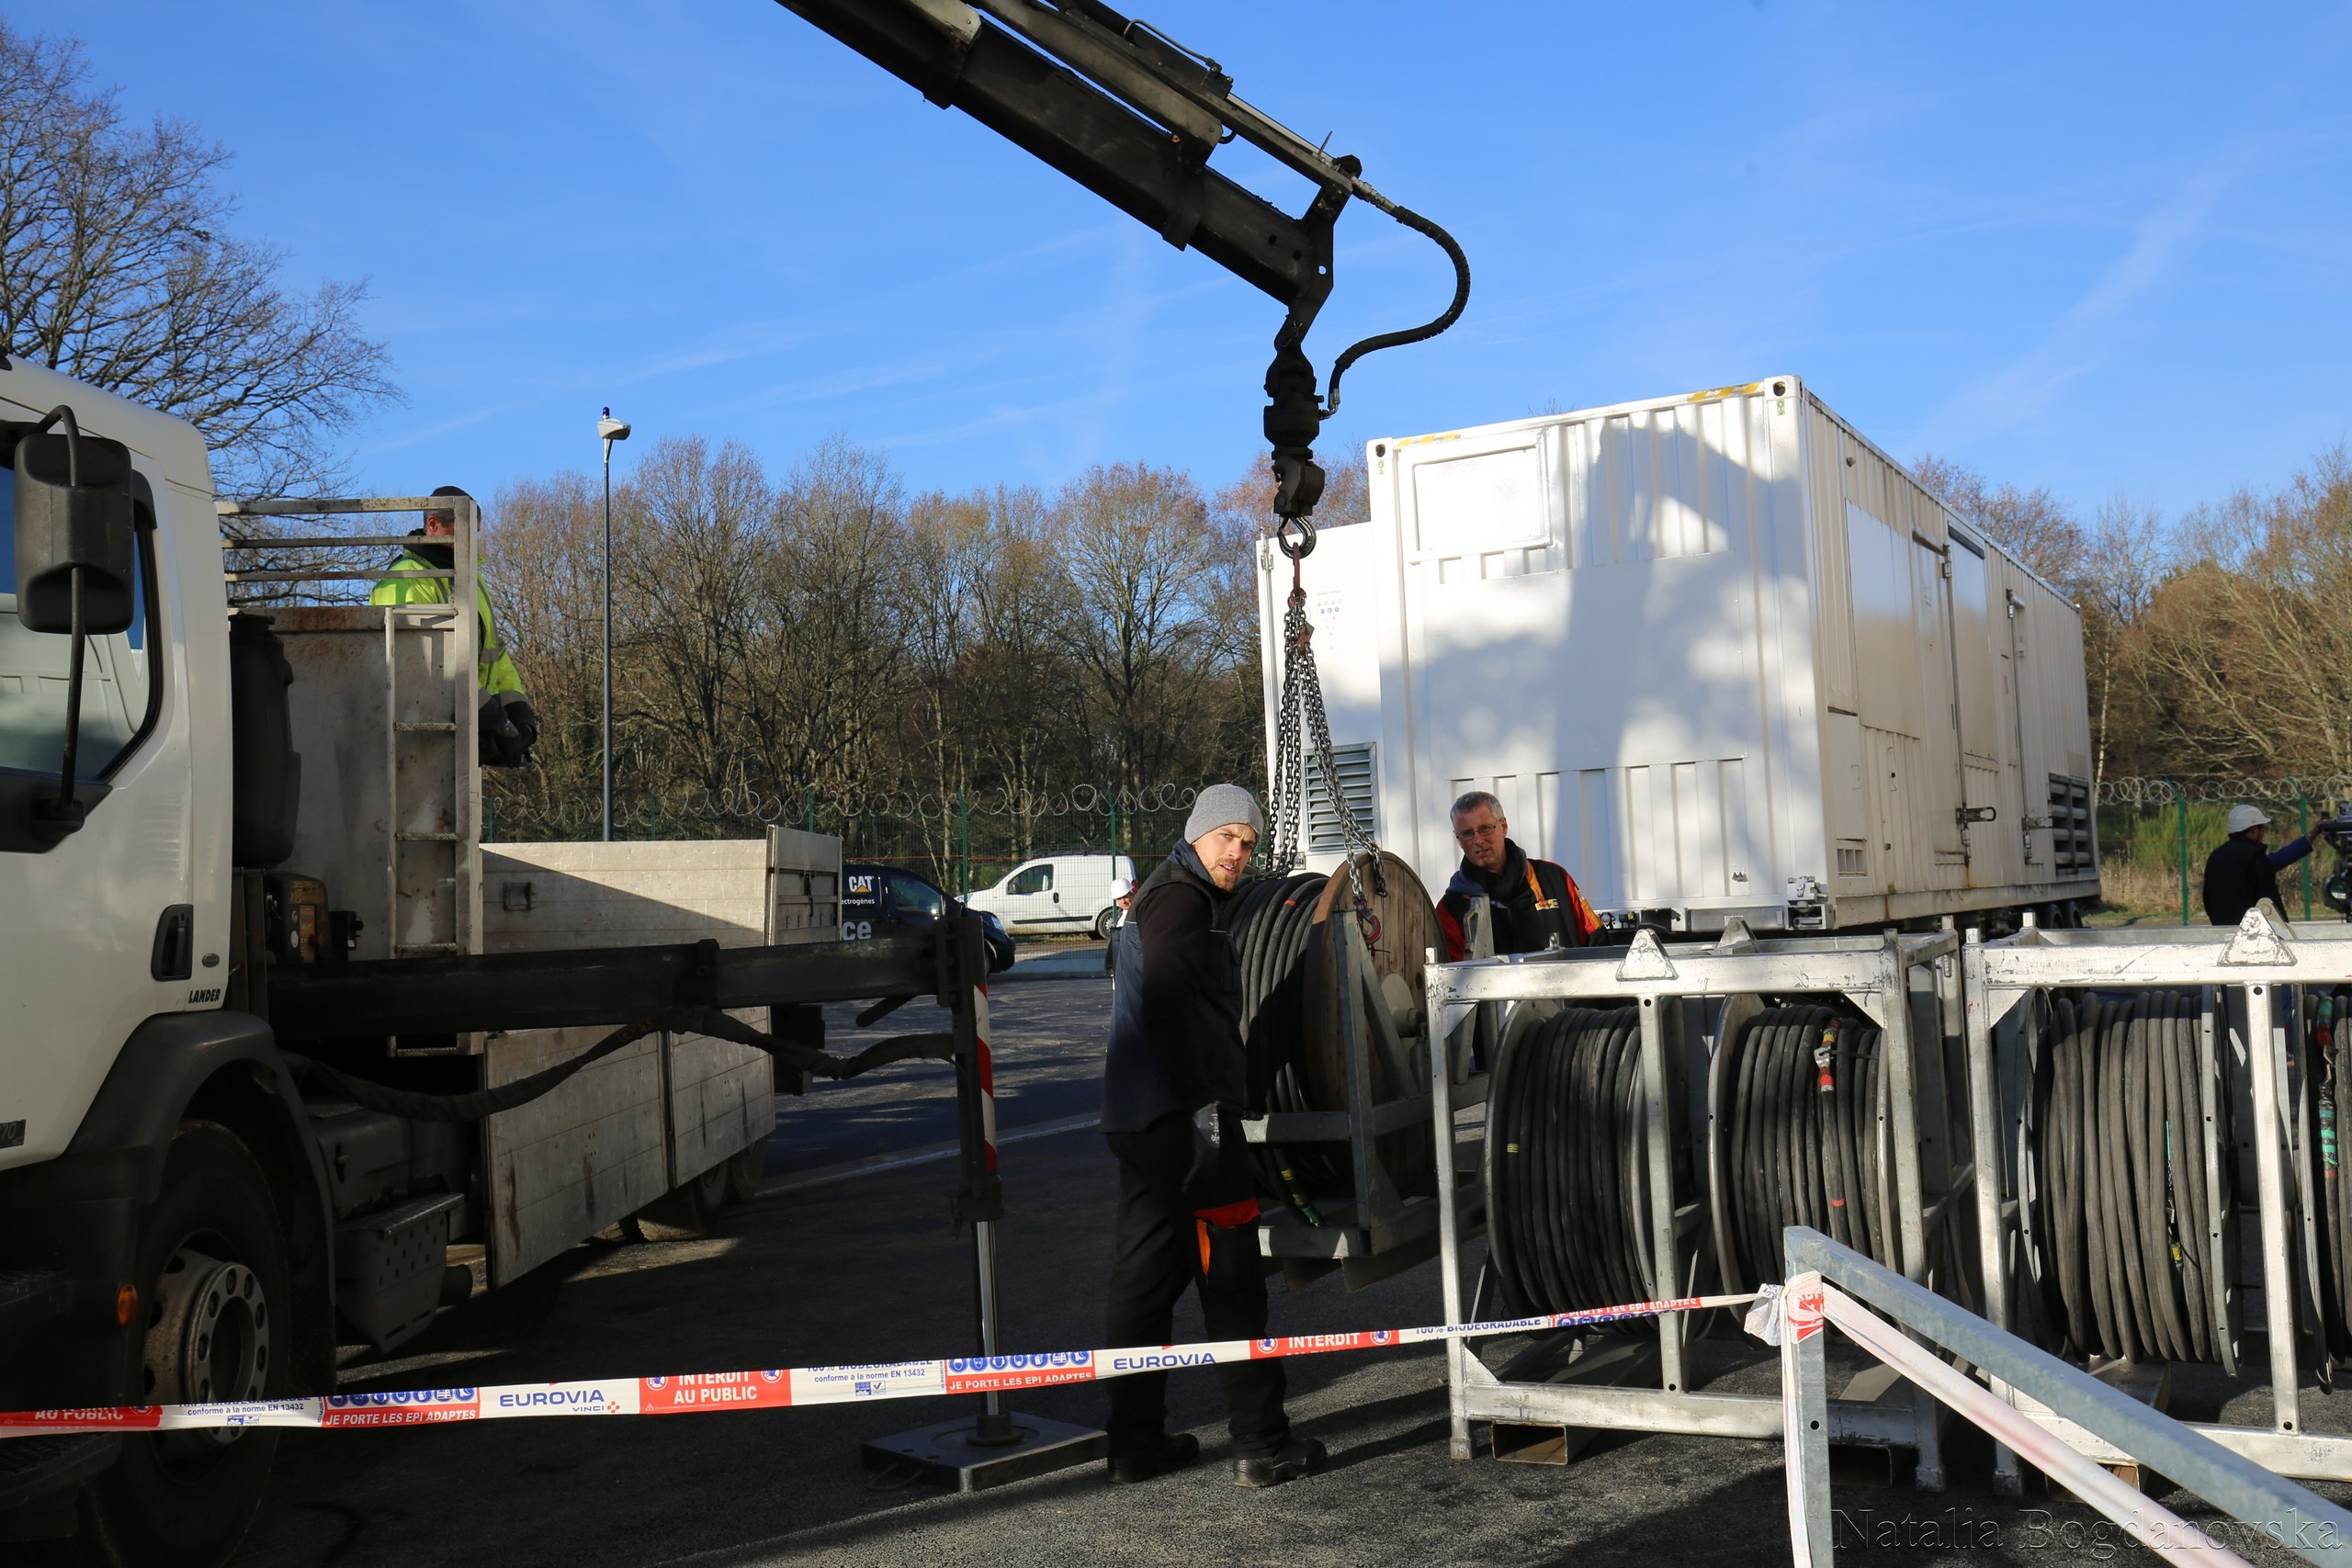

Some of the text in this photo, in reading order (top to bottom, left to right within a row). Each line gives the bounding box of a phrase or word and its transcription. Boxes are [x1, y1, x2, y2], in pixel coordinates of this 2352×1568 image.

[849, 875, 873, 892] CAT
[842, 921, 872, 941] ce
[188, 988, 221, 1003] LANDER
[0, 1122, 17, 1141] 70
[1447, 1319, 1542, 1332] BIODEGRADABLE
[1288, 1333, 1361, 1349] INTERDIT
[1114, 1352, 1216, 1370] EUROVIA
[679, 1371, 750, 1386] INTERDIT
[814, 1373, 848, 1382] conforme
[903, 1369, 925, 1377] 13432
[950, 1372, 1091, 1390] JE PORTE LES EPI ADAPTES
[500, 1389, 605, 1407] EUROVIA
[673, 1385, 757, 1404] AU PUBLIC
[187, 1406, 223, 1416] conforme
[281, 1403, 304, 1411] 13432
[326, 1409, 476, 1425] JE PORTE LES EPI ADAPTES
